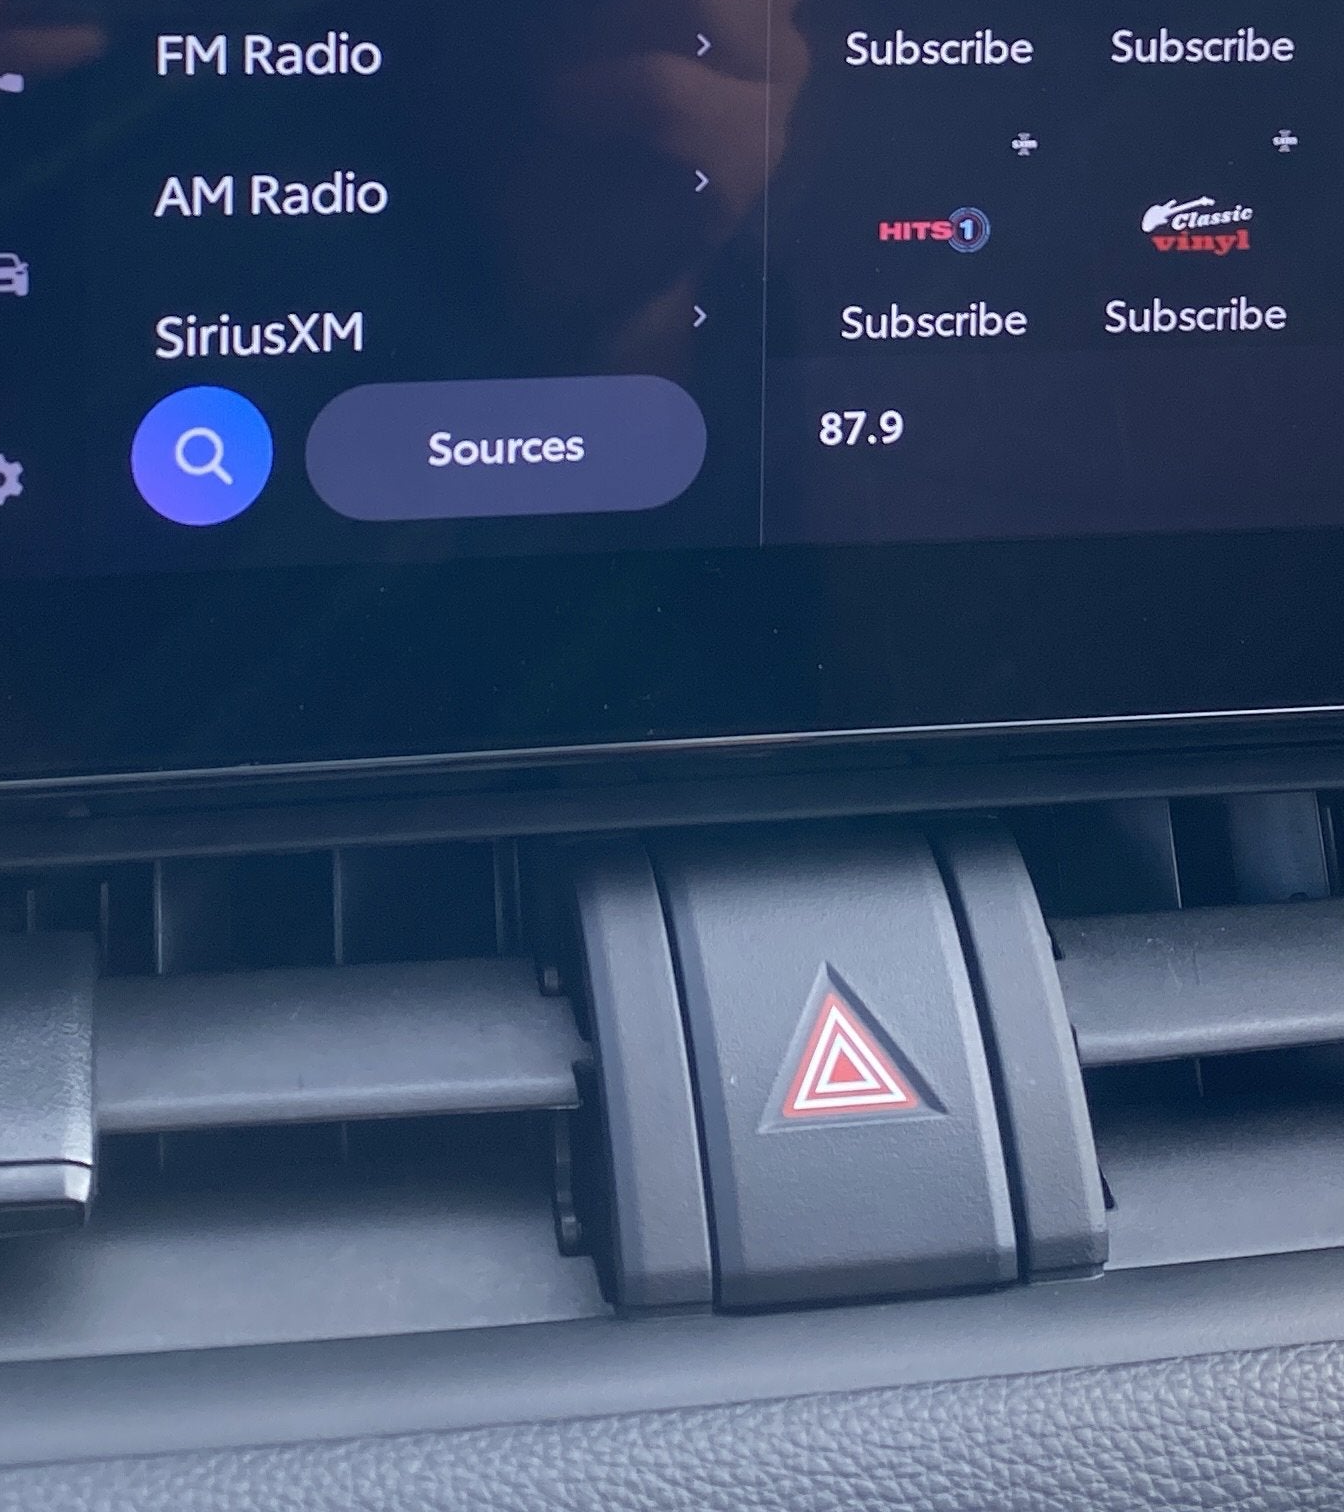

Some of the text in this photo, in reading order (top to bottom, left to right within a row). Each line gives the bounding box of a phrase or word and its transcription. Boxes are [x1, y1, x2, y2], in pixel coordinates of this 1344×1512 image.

[157, 31, 383, 76] FM Radio
[845, 28, 1034, 66] Subscribe
[1110, 26, 1296, 63] Subscribe
[154, 170, 389, 218] AM Radio
[878, 220, 955, 241] HITS
[1171, 204, 1254, 231] Classic
[1152, 228, 1250, 257] vinyl
[841, 301, 1028, 340] Subscribe
[1104, 296, 1288, 334] Subscribe
[156, 311, 364, 359] SiriusXM
[819, 409, 905, 446] 87.9
[428, 431, 585, 467] Sources
